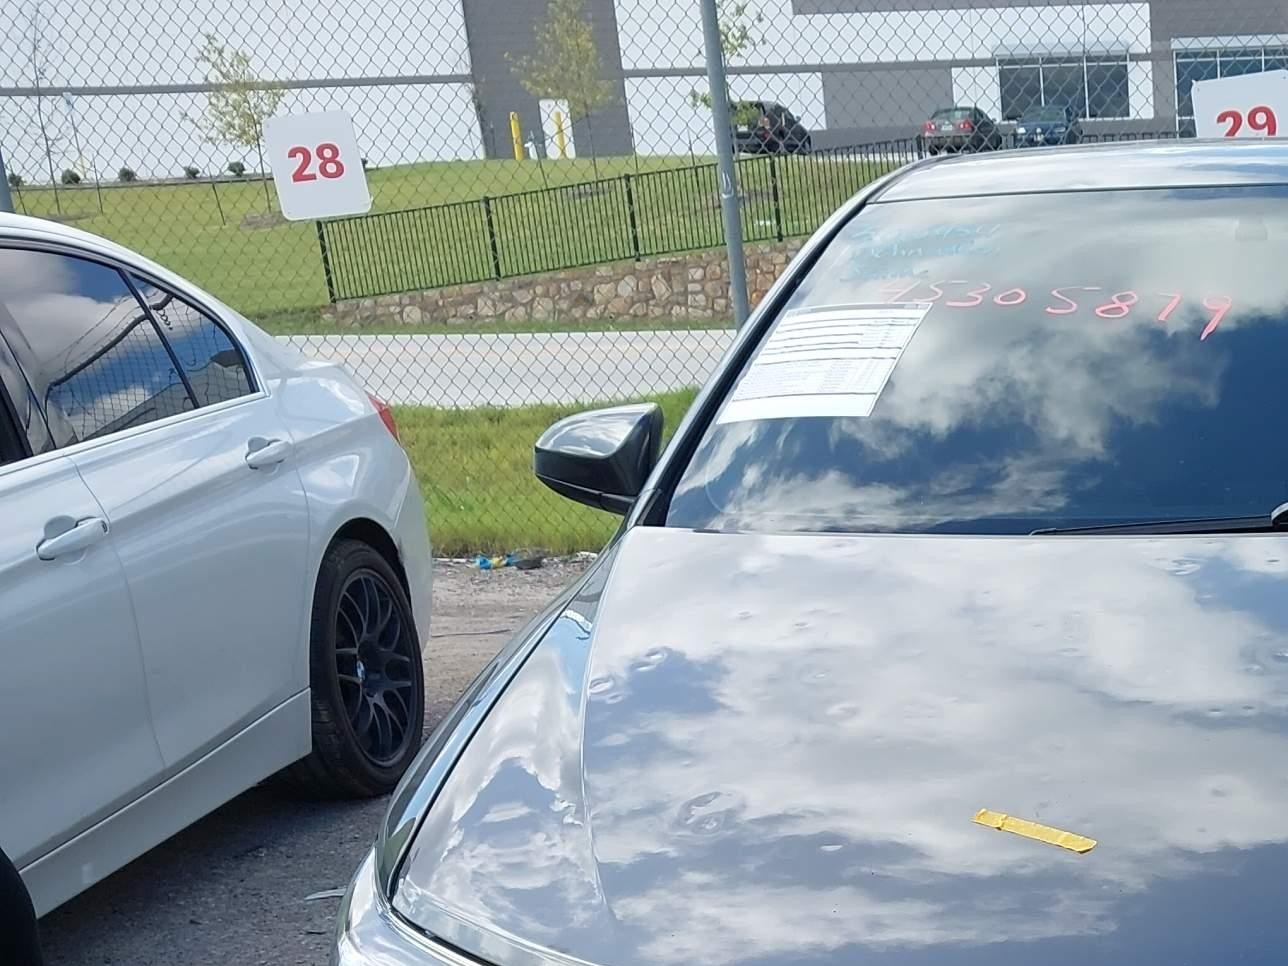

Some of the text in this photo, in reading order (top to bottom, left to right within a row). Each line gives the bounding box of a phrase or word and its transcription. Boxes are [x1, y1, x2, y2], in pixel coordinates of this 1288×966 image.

[1216, 106, 1277, 137] 29
[287, 143, 345, 182] 28
[878, 280, 1232, 341] 45305879
